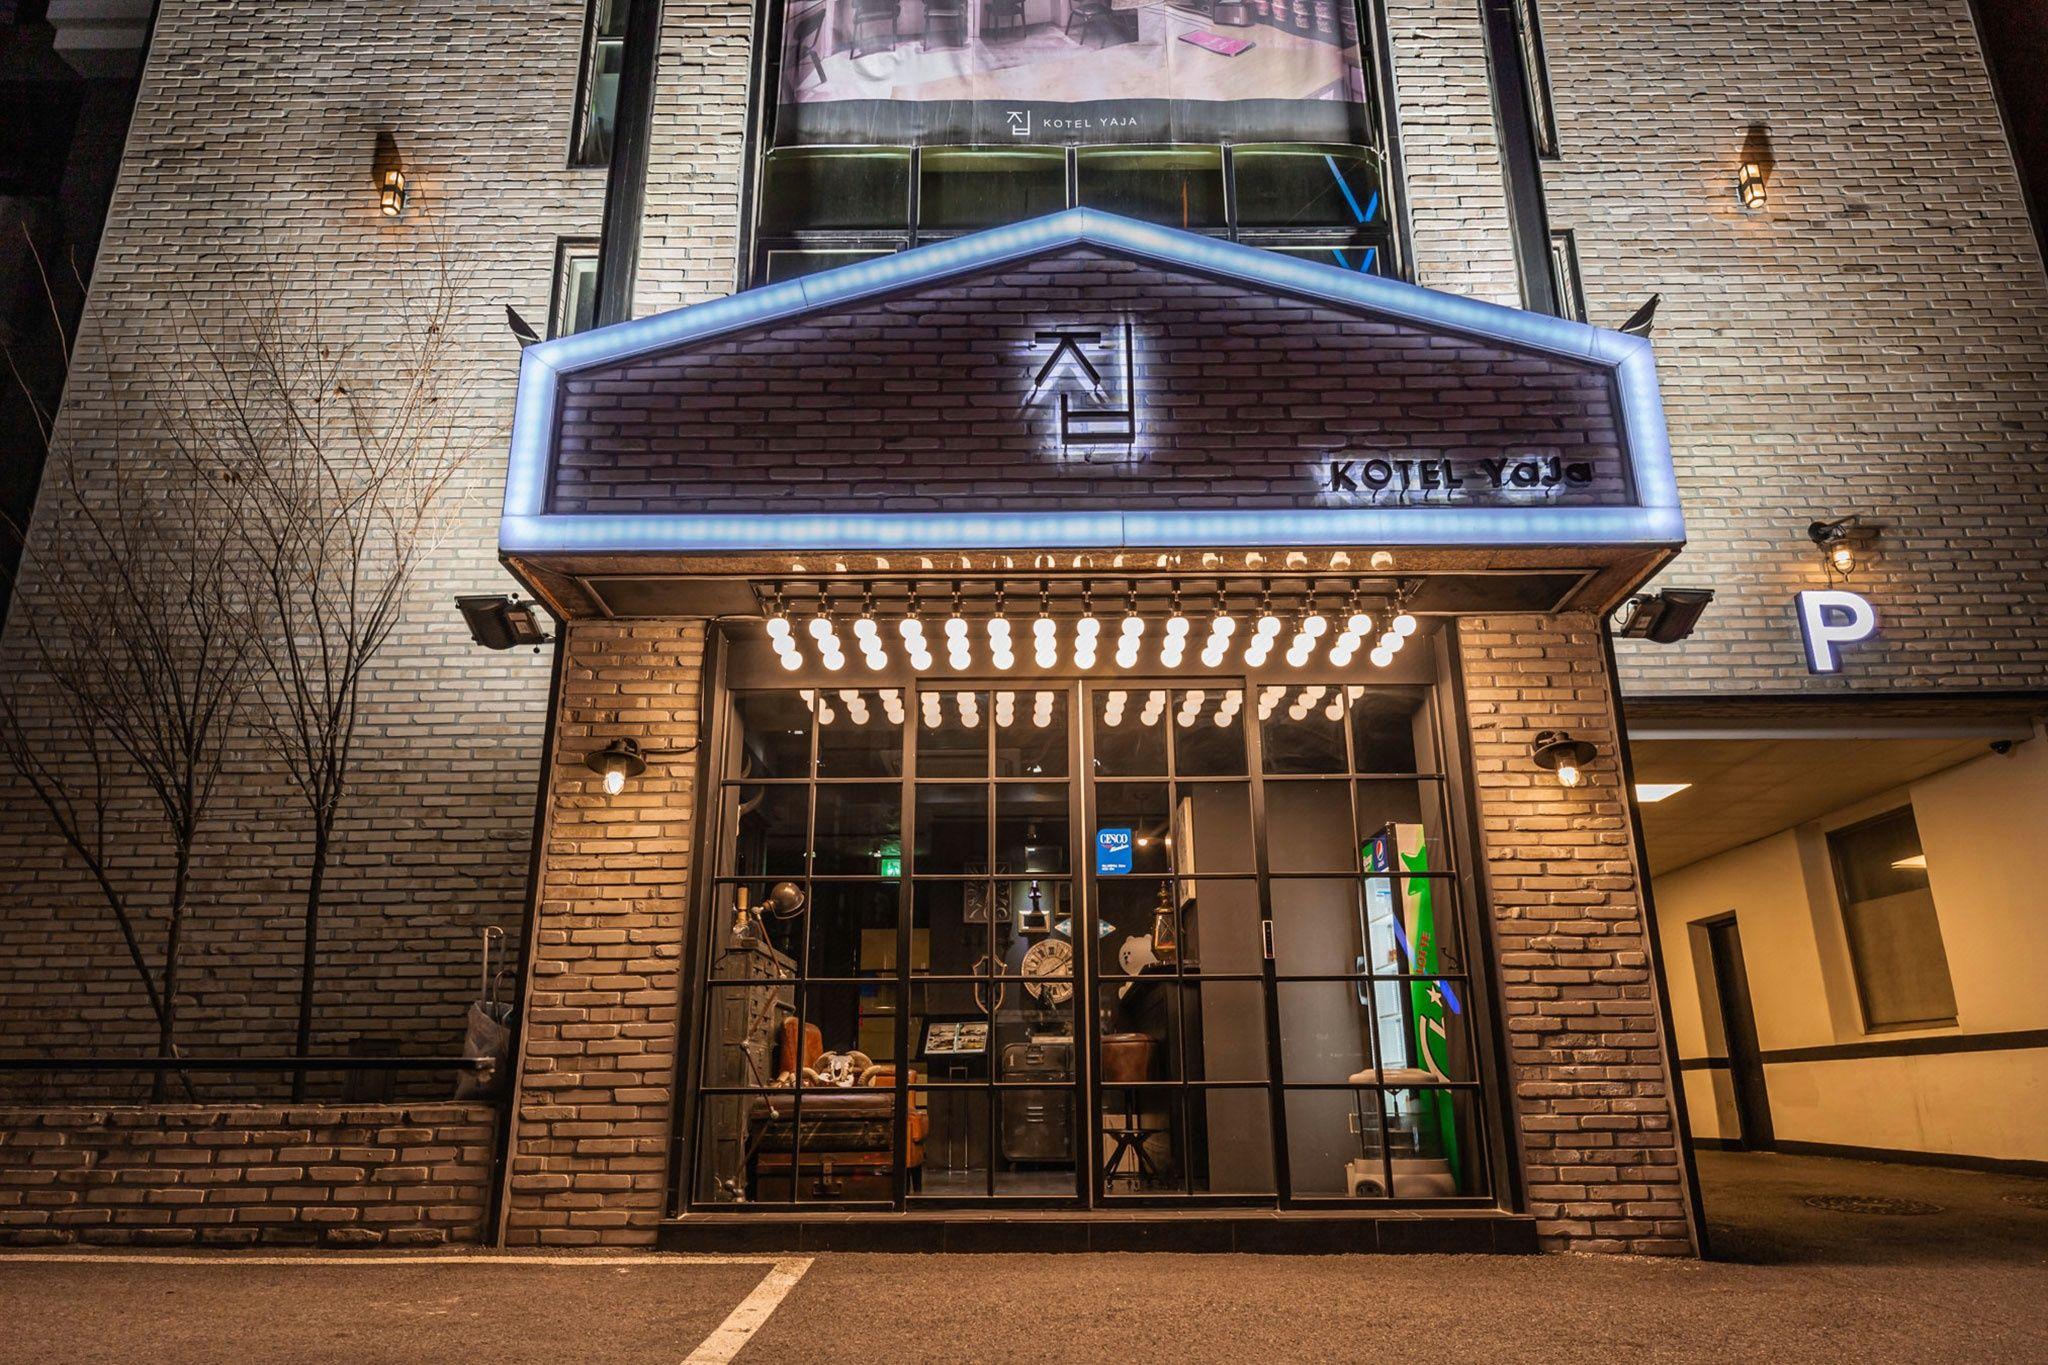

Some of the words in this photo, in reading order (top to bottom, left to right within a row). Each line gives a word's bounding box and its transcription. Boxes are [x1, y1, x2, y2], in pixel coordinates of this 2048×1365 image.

[1006, 110, 1030, 136] 집
[1043, 119, 1092, 129] KOTEL
[1100, 117, 1137, 127] YAJA
[1034, 323, 1136, 445] 집
[1329, 458, 1464, 492] KOTEL
[1794, 590, 1877, 674] P
